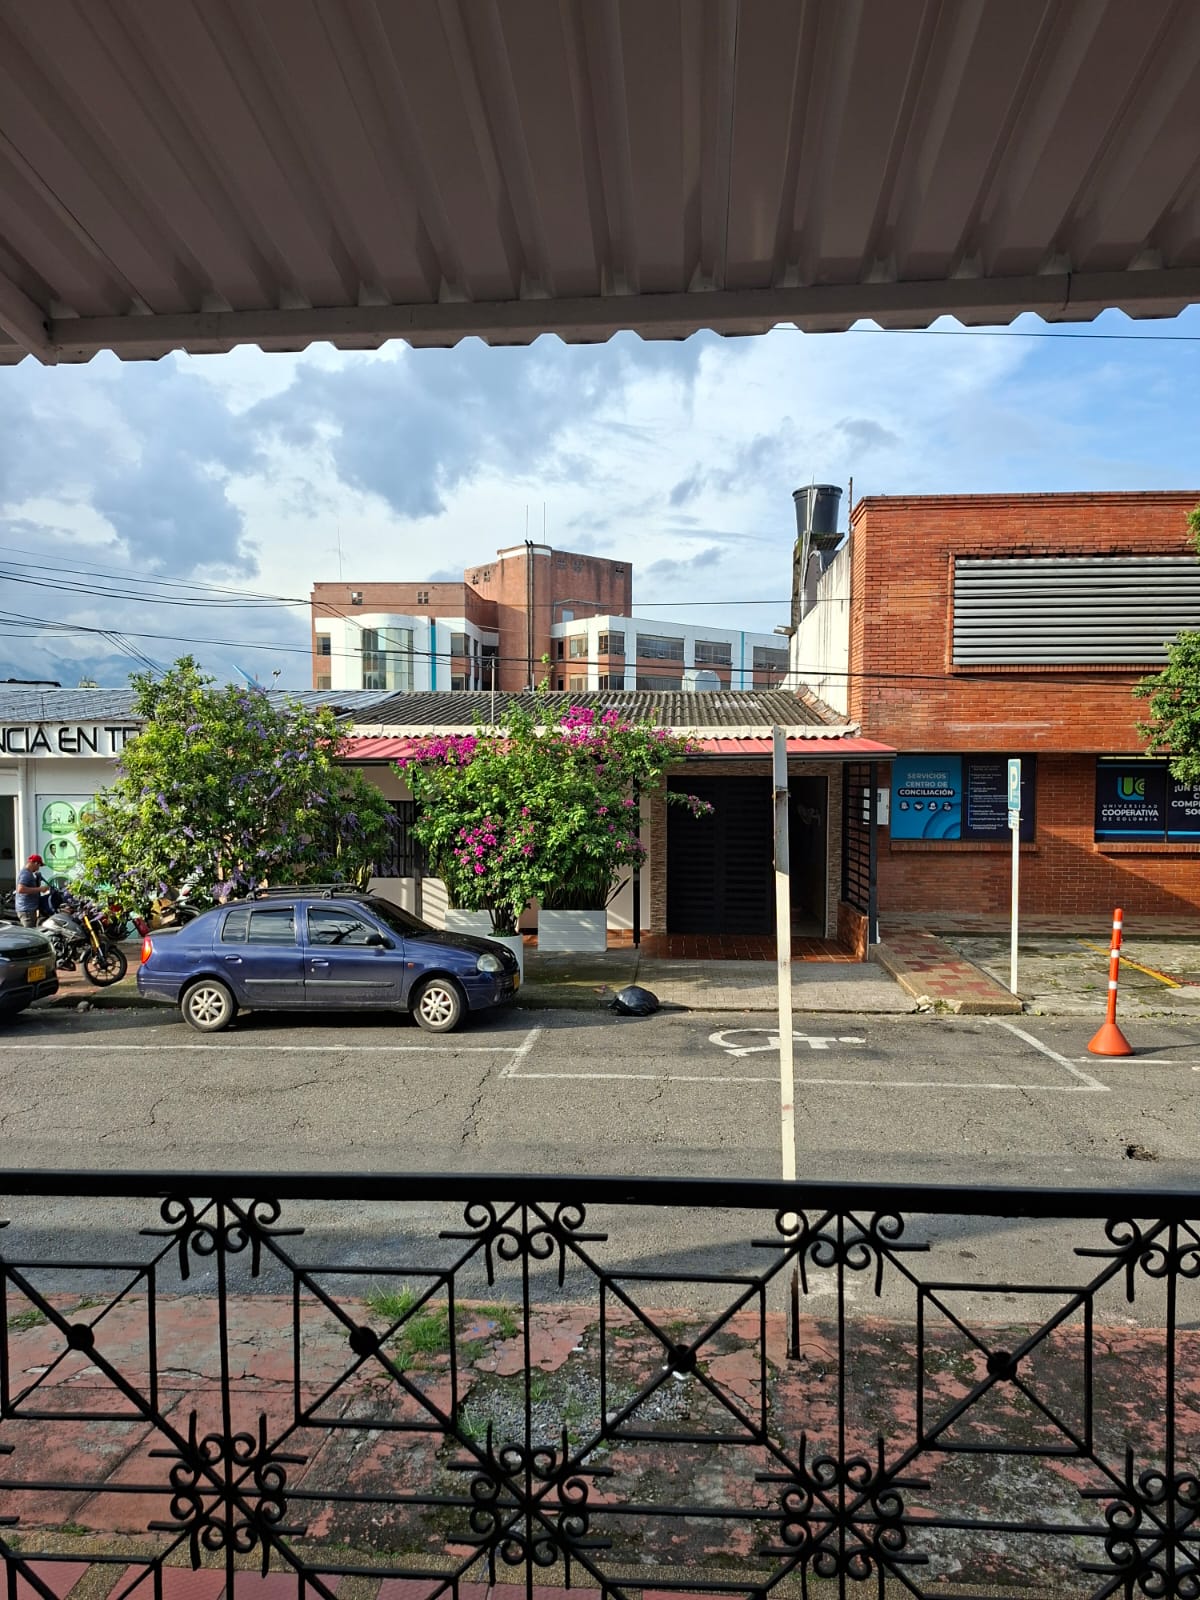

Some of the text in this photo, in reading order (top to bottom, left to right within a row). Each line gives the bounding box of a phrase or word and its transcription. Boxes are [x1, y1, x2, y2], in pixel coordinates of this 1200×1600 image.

[0, 727, 51, 752] CIA
[59, 727, 98, 752] EN
[899, 788, 954, 796] CONCILIACIÓN
[1192, 784, 1200, 792] S
[1171, 800, 1200, 808] COMP
